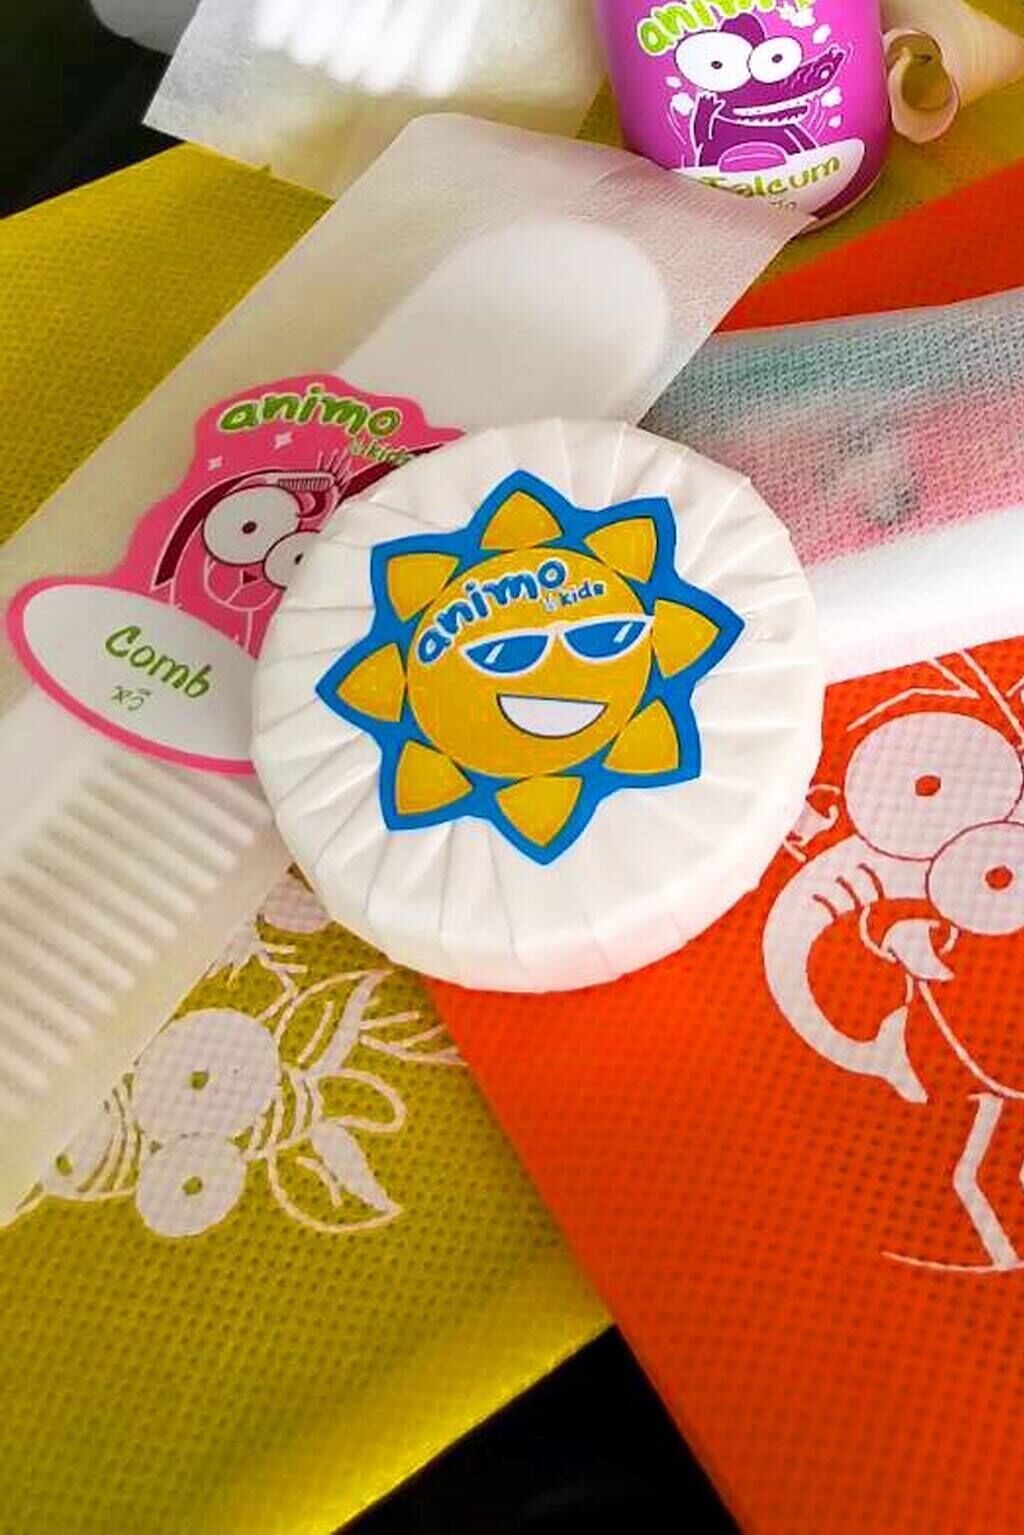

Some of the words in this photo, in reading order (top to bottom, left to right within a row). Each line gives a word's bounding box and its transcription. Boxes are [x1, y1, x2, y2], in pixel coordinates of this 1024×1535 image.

[218, 382, 403, 438] animo
[417, 558, 569, 664] animo
[559, 580, 605, 606] kids
[104, 625, 213, 699] Comb
